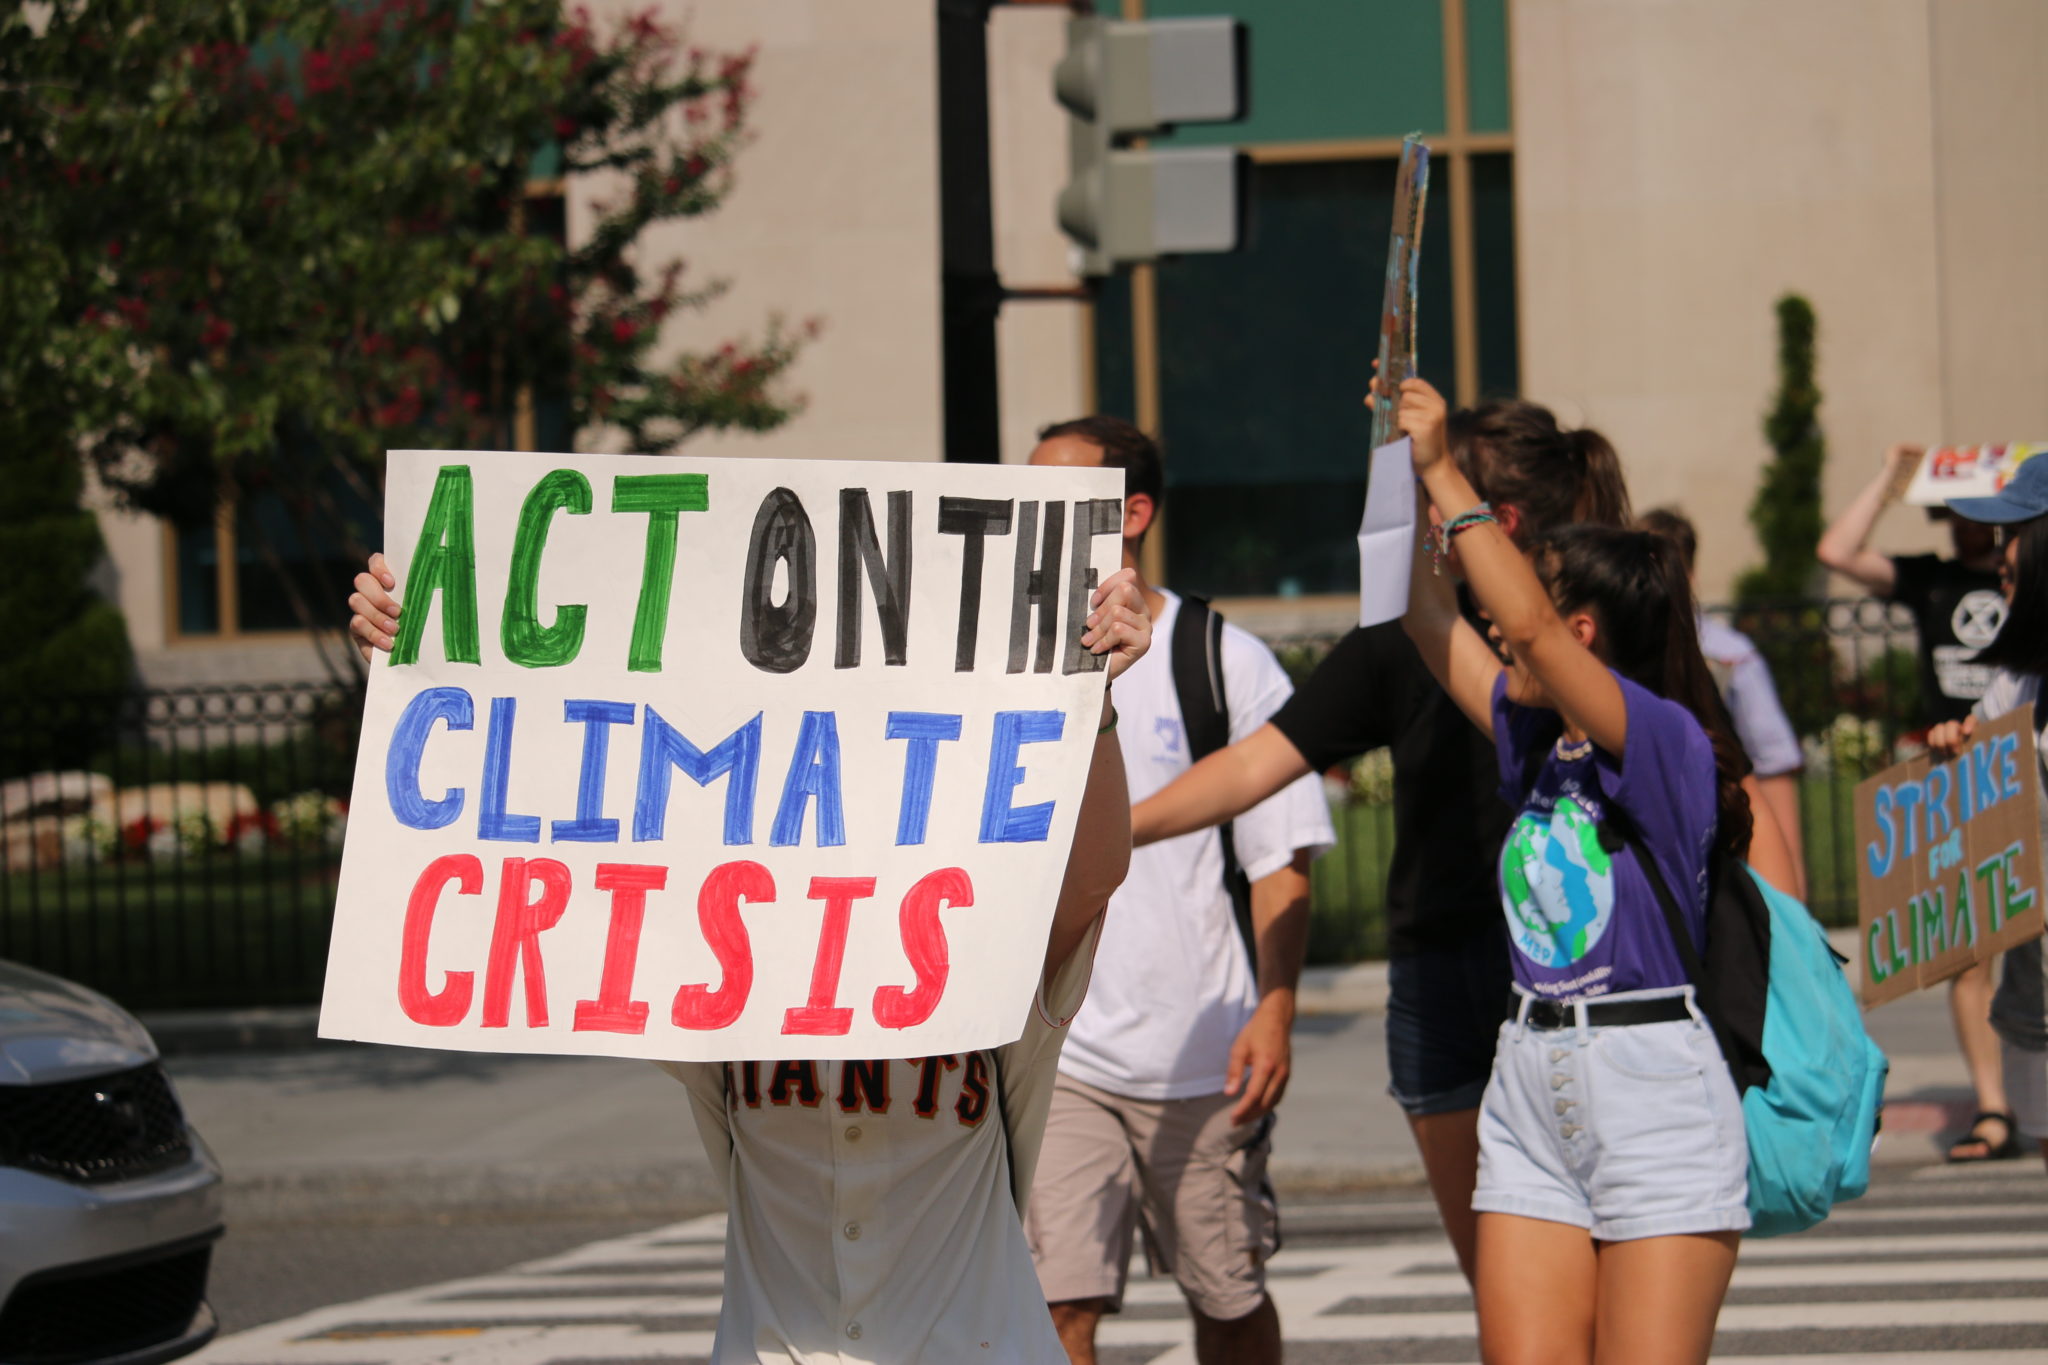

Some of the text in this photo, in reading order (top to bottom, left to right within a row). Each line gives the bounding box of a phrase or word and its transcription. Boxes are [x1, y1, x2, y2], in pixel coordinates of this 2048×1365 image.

[390, 464, 1121, 675] ACT ON THE
[386, 687, 1066, 847] CLIMATE
[1867, 731, 2021, 879] STRIKE
[1867, 839, 2036, 985] CLIMATE
[1927, 828, 1963, 880] FOR
[397, 853, 974, 1036] CRISIS
[728, 1051, 990, 1128] IANTS
